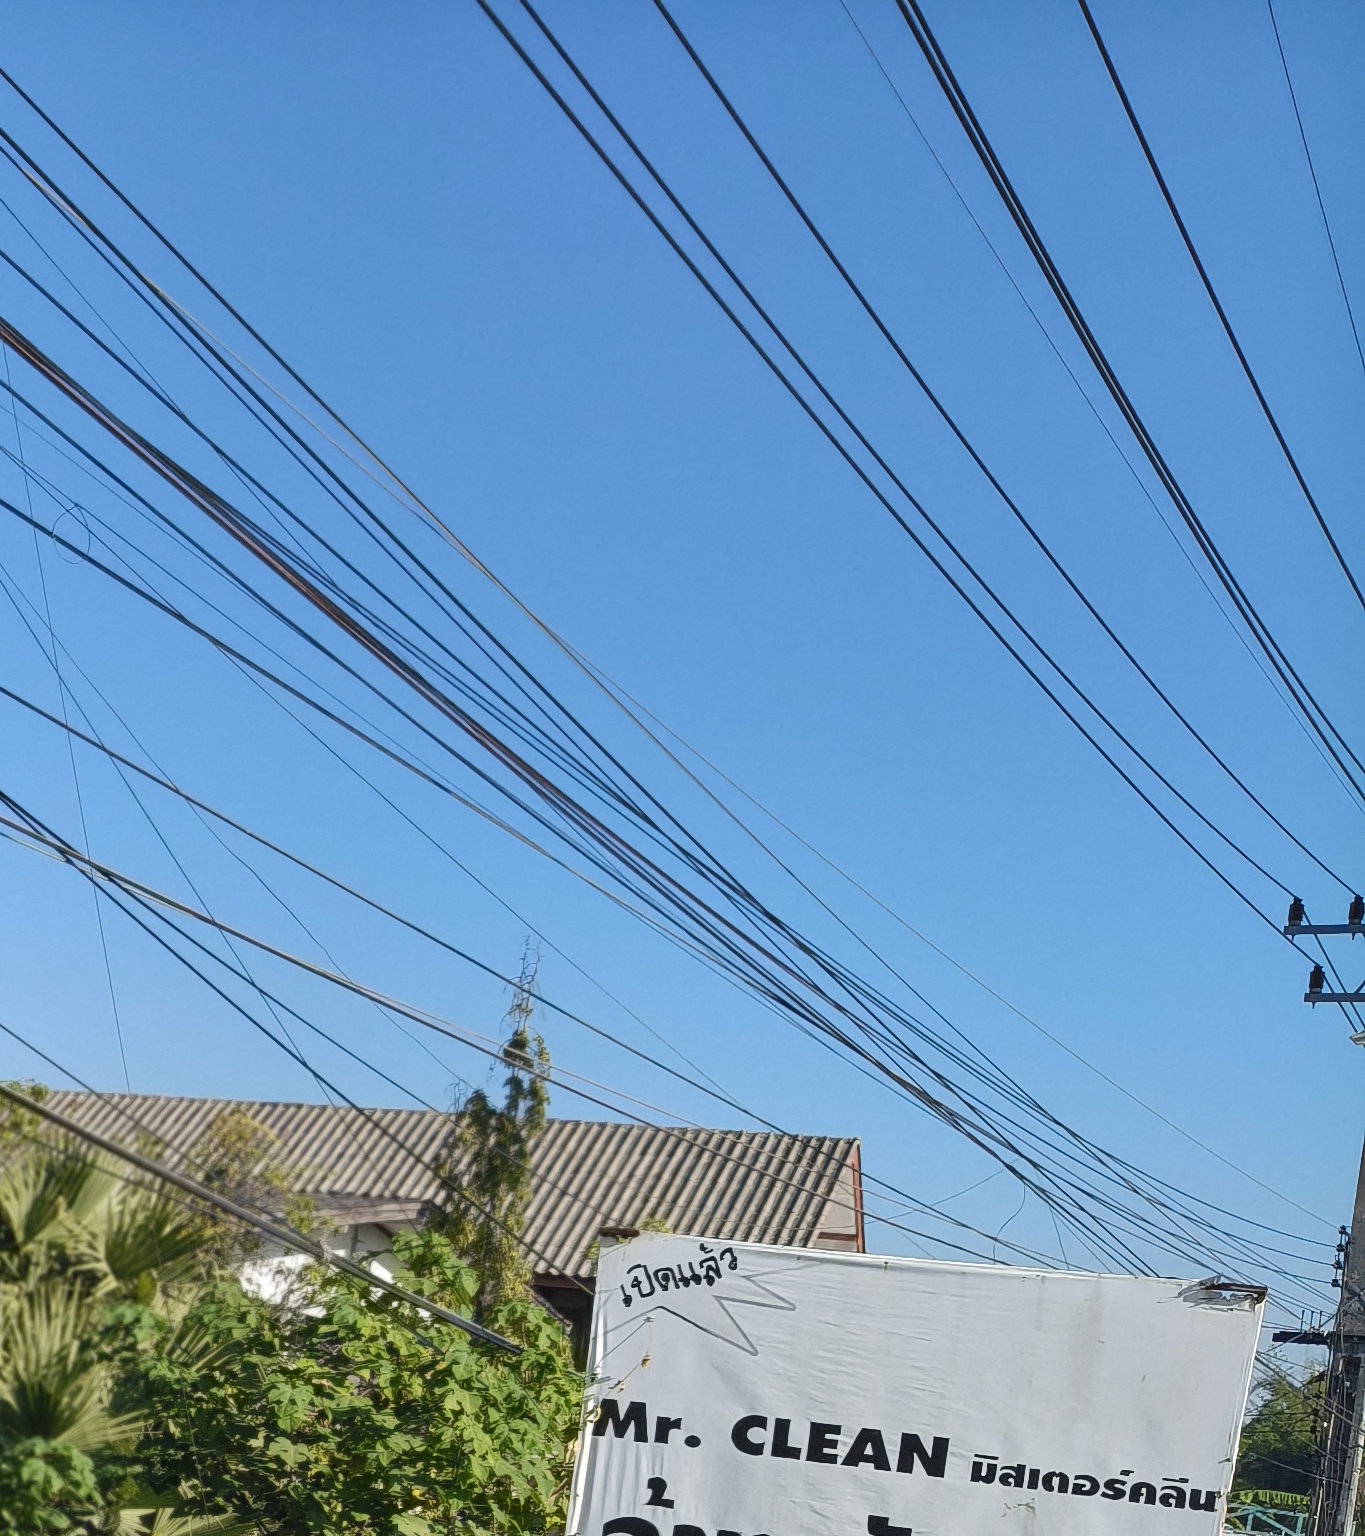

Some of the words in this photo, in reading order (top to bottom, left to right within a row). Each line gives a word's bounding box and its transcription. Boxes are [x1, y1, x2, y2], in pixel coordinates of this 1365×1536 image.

[619, 1242, 738, 1307] เปิดแล้ว
[591, 1398, 702, 1448] Mr.
[731, 1414, 950, 1478] CLEAN
[969, 1453, 1219, 1512] มิสเตอร์คลีน
